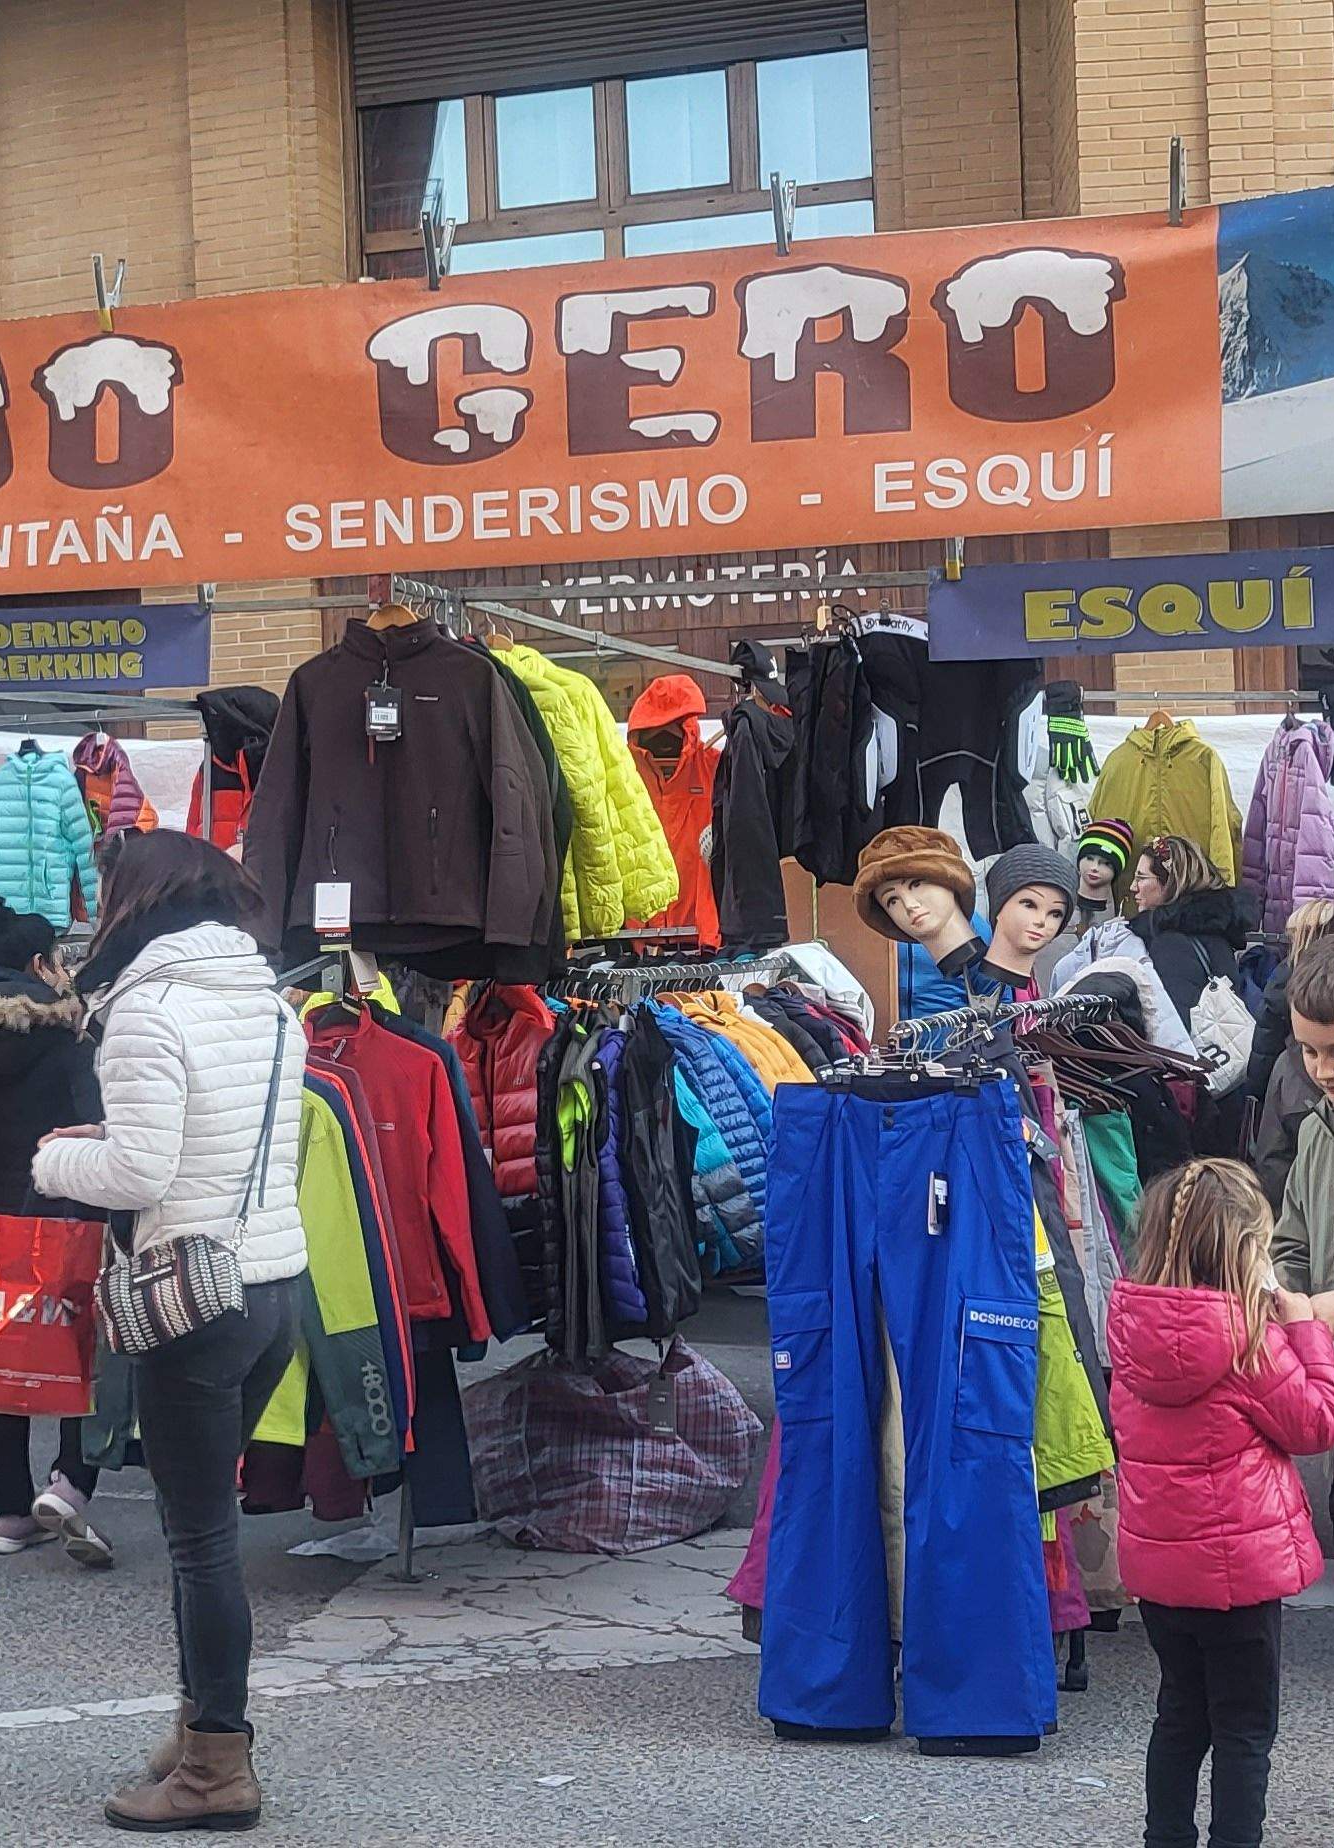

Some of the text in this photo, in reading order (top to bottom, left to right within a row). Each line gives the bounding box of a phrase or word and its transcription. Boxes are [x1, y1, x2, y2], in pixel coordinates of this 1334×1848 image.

[284, 473, 749, 552] SENDERISMO
[874, 433, 1116, 514] ESQUÍ
[1023, 565, 1316, 643] ESQUÍ
[970, 1310, 1038, 1331] DCSHOECO
